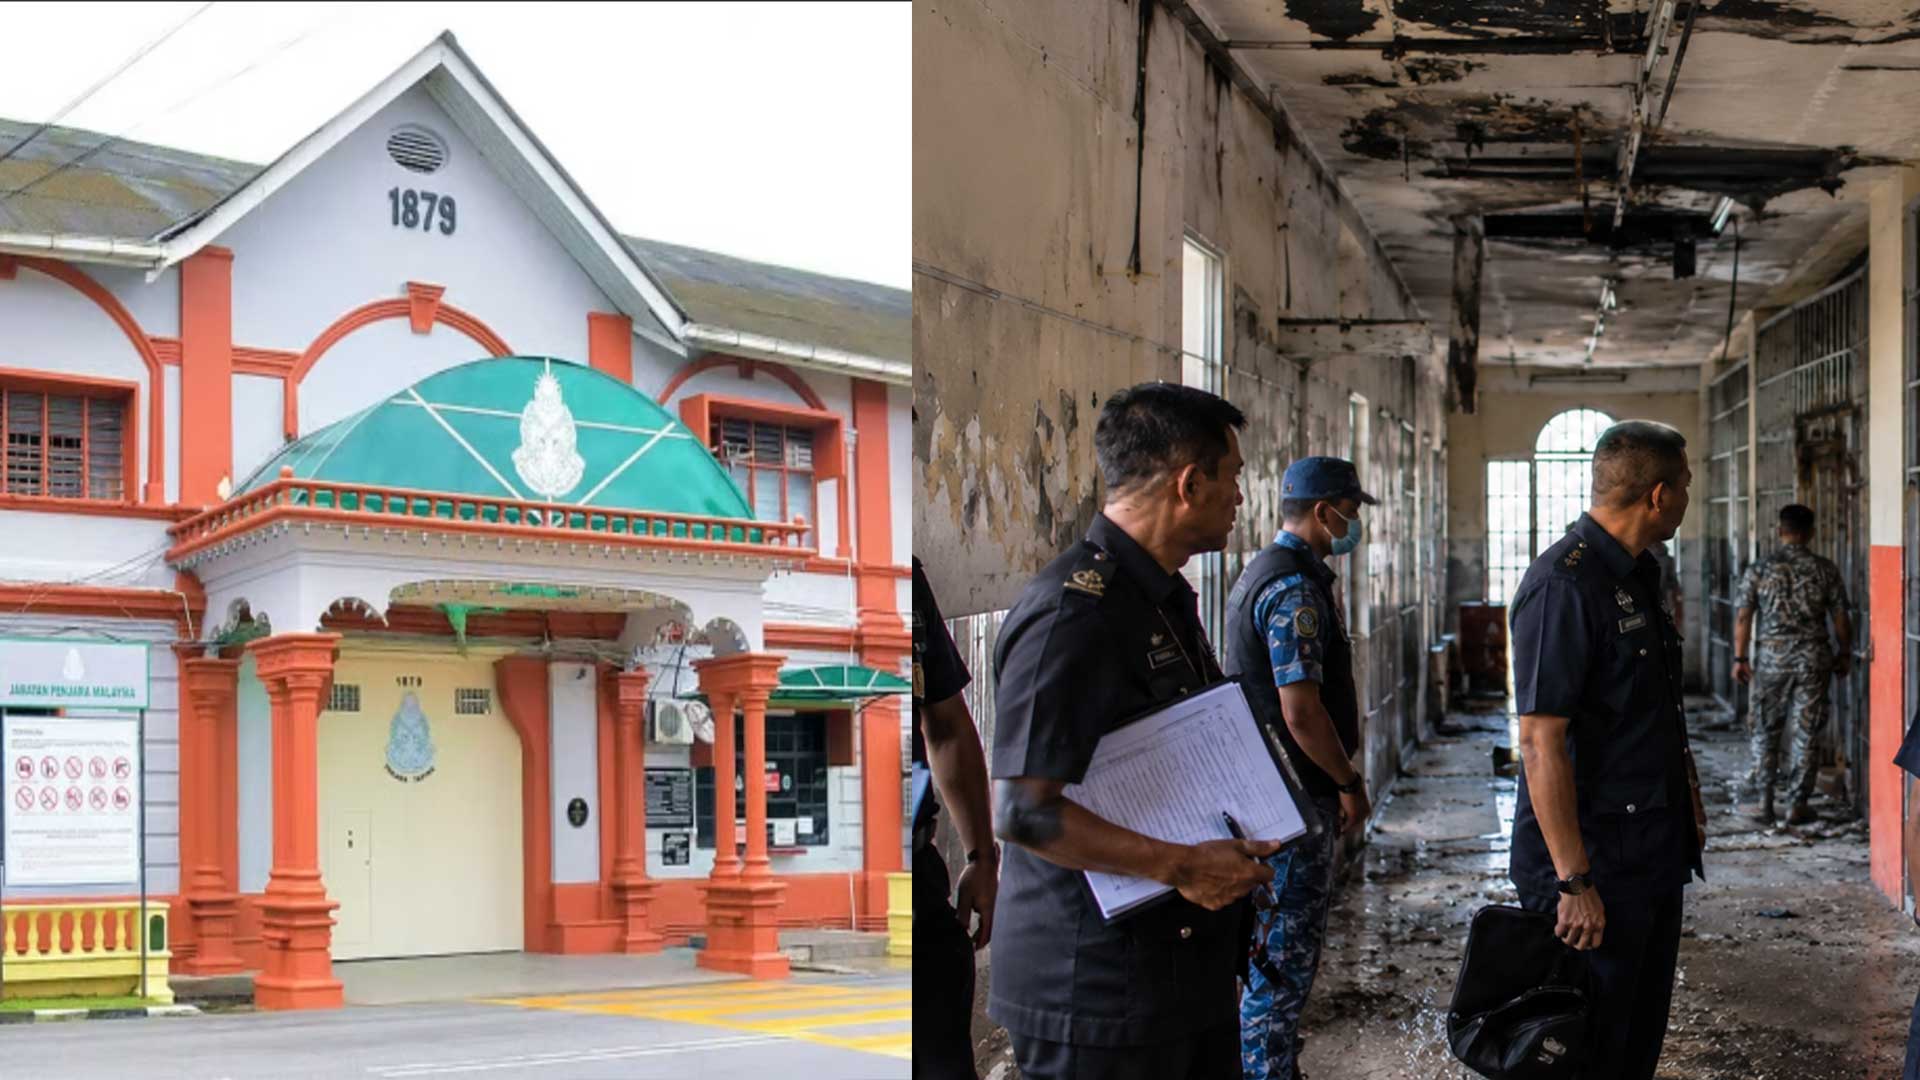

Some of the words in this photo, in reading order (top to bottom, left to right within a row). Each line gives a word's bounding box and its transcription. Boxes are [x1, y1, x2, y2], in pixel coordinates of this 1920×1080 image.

[388, 186, 456, 236] 1879
[395, 676, 422, 687] 1879
[9, 684, 48, 696] JABATAN
[51, 685, 91, 697] PENJARA
[93, 686, 136, 699] MALAYSIA
